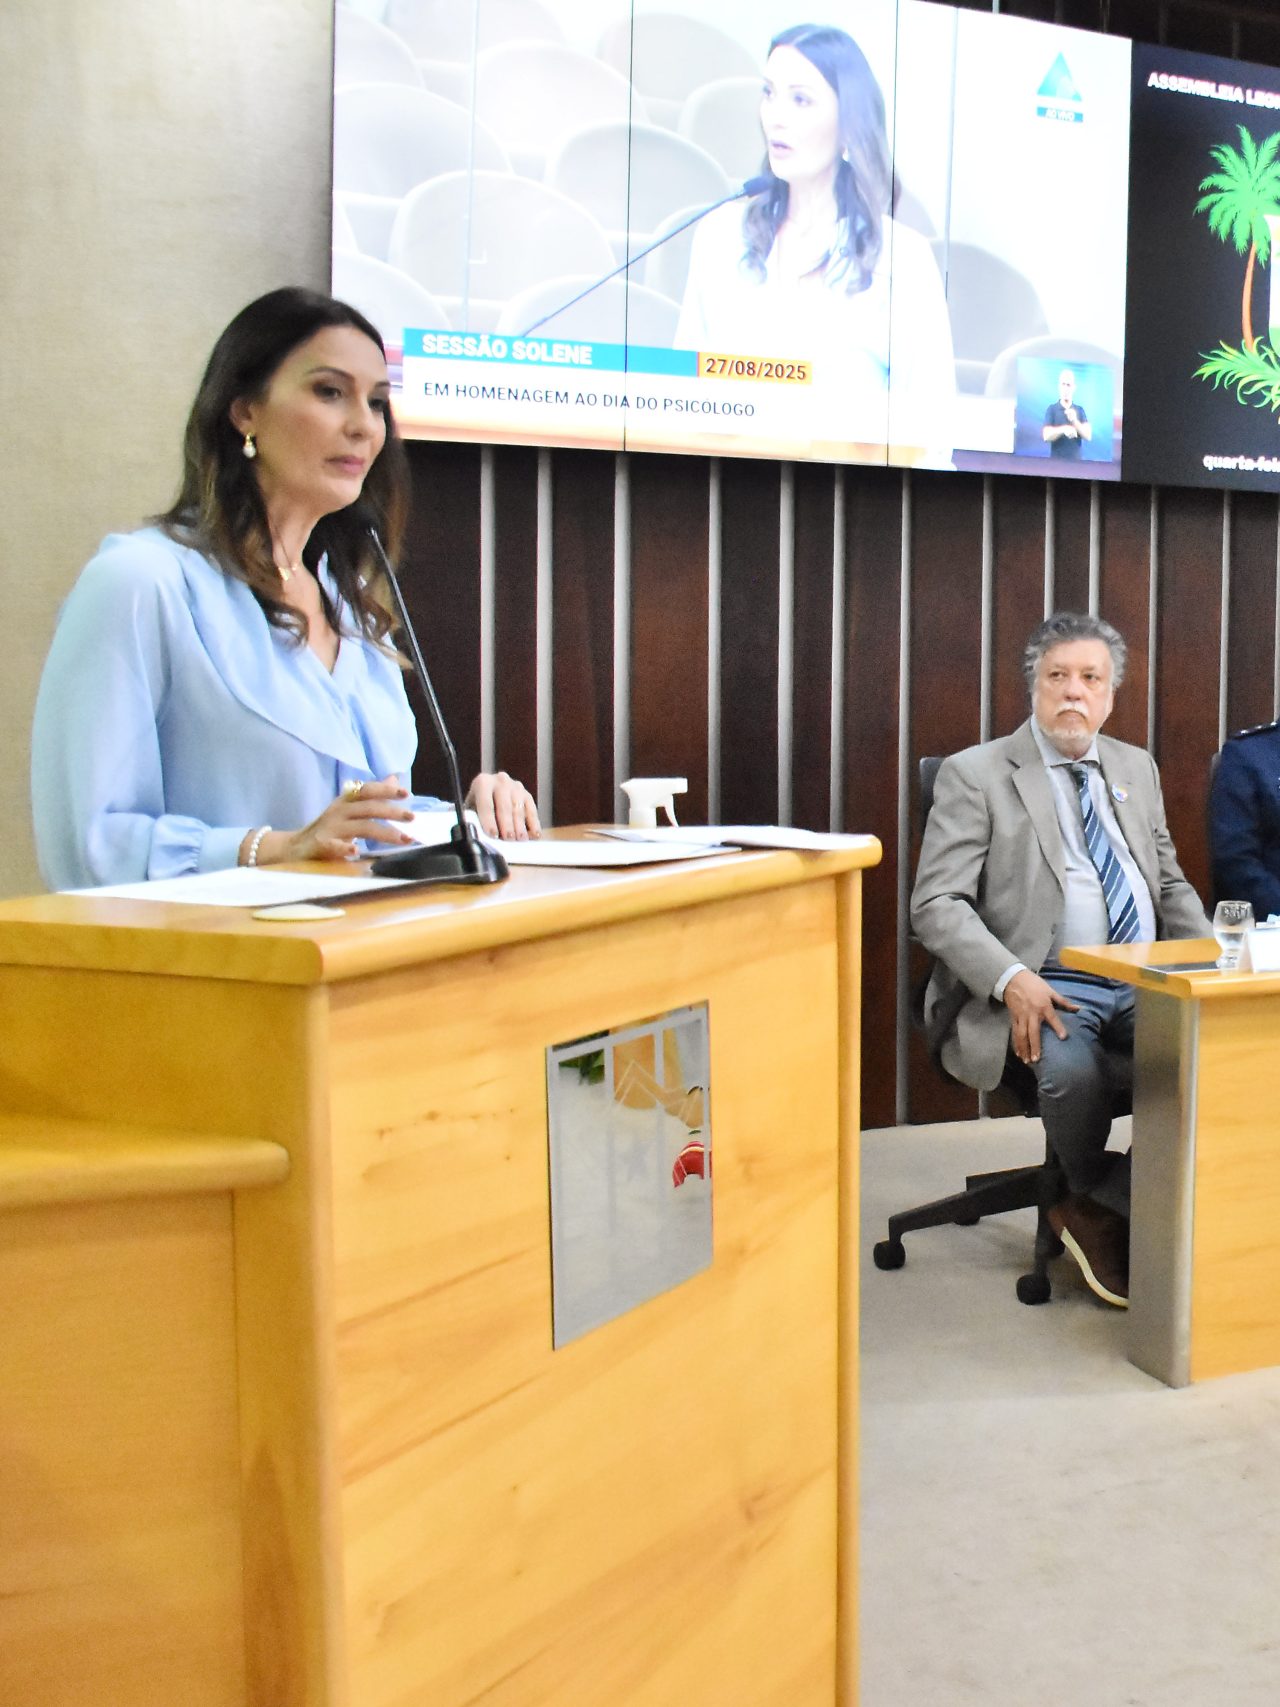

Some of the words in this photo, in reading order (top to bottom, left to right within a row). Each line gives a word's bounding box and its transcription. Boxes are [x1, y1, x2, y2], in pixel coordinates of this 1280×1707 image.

[422, 332, 508, 359] SESSÃO
[512, 340, 593, 366] SOLENE
[704, 357, 808, 381] 27/08/2025
[424, 382, 451, 398] EM
[455, 384, 570, 405] HOMENAGEM
[574, 391, 598, 407] AO
[602, 394, 630, 409] DIA
[635, 396, 659, 411] DO
